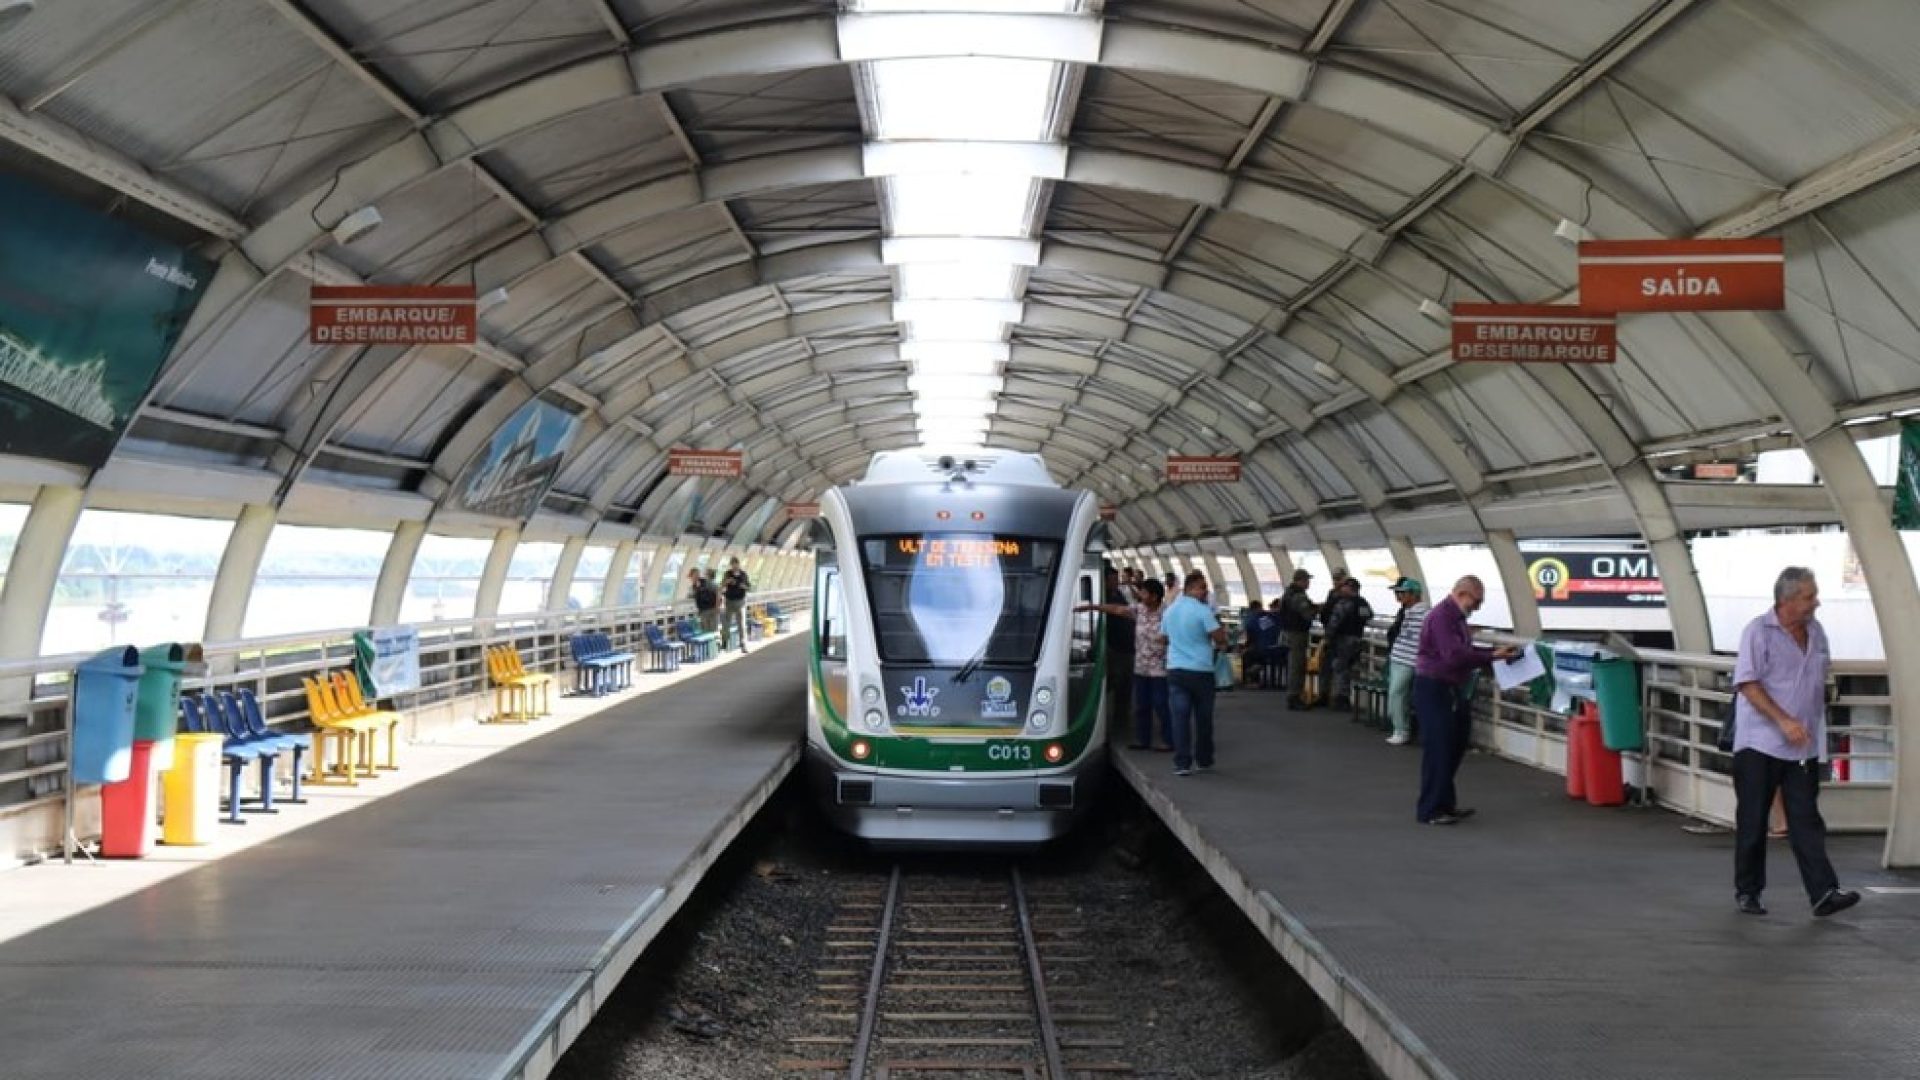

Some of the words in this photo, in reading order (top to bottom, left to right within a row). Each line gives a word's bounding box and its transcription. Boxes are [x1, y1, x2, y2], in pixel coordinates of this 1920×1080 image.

[1641, 268, 1721, 296] SAÍDA
[335, 307, 456, 322] EMBARQUE/
[317, 325, 467, 340] DESEMBARQUE
[1475, 325, 1597, 342] EMBARQUE/
[1459, 343, 1609, 360] DESEMBARQUE
[899, 539, 926, 553] VLT
[988, 744, 1031, 760] C013
